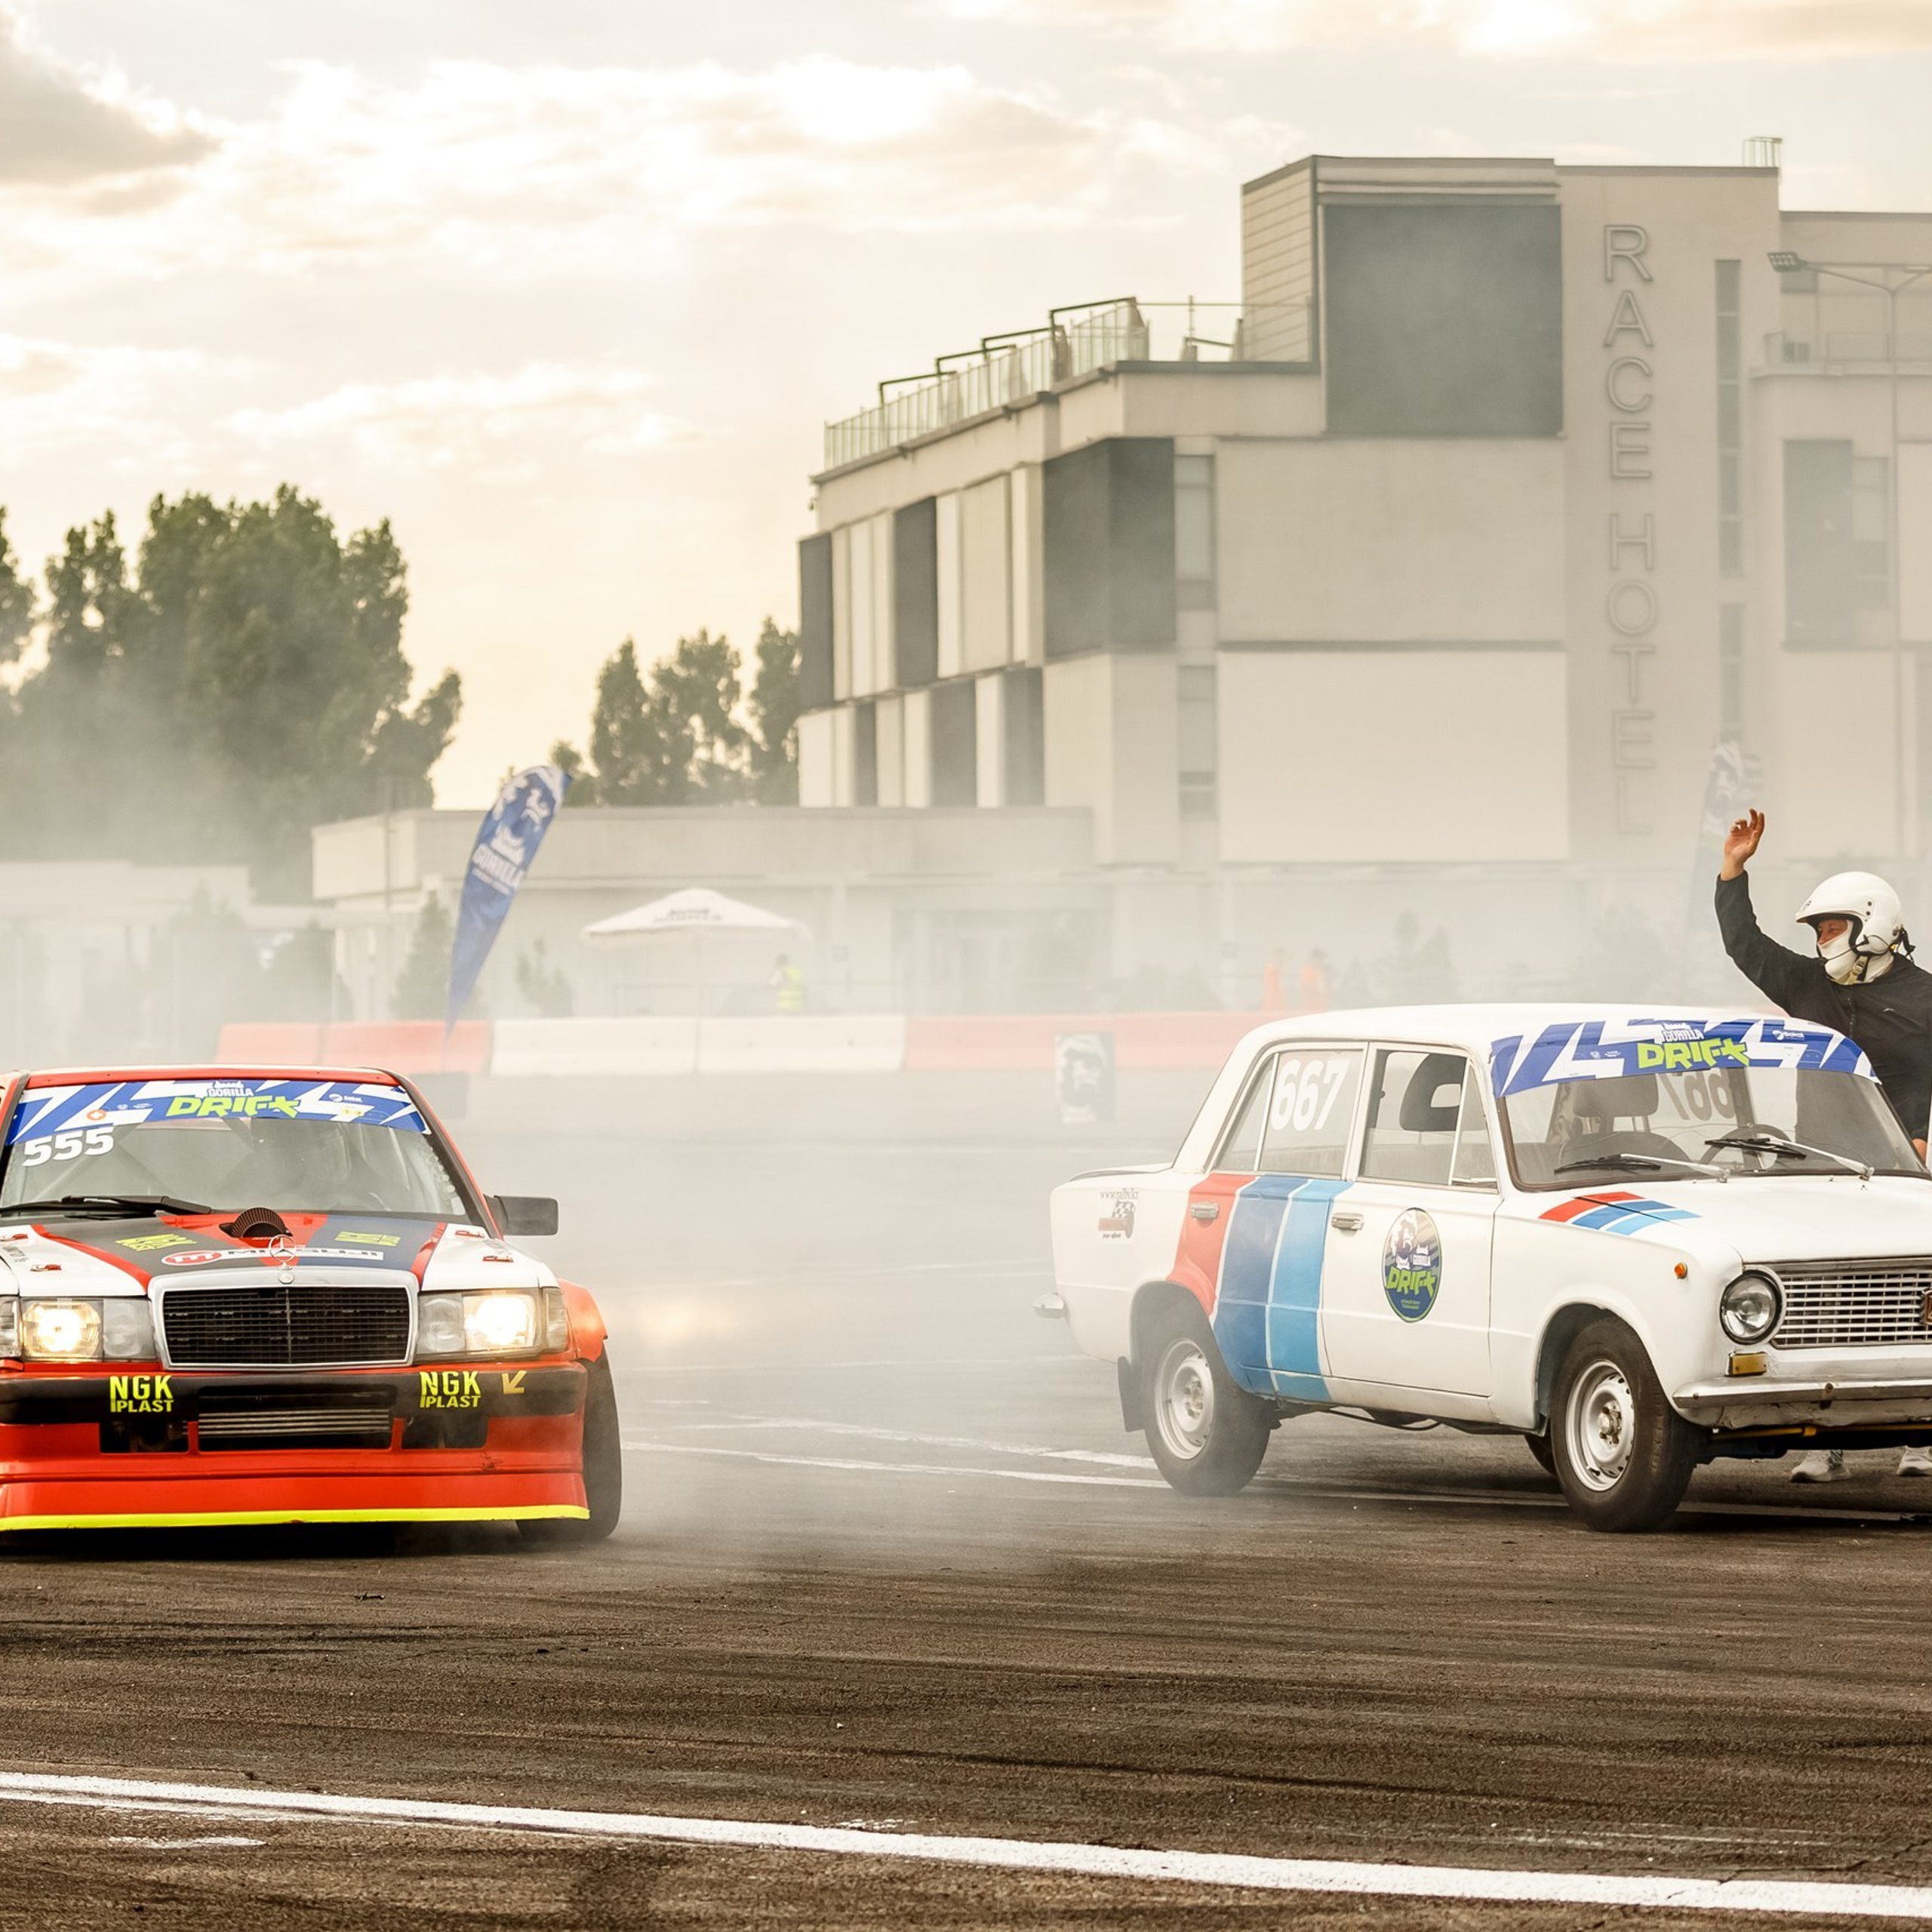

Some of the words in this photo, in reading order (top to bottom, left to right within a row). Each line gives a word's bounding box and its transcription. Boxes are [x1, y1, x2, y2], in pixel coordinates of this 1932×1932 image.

[1603, 224, 1654, 481] RACE
[1607, 513, 1657, 836] HOTEL
[1663, 1029, 1704, 1041] GORILLA
[208, 1088, 254, 1097] GORILLA
[1271, 1059, 1350, 1131] 667
[22, 1126, 114, 1167] 555
[109, 1375, 173, 1400] NGK
[419, 1371, 481, 1395] NGK
[116, 1400, 174, 1413] PLAST
[425, 1395, 481, 1408] PLAST
